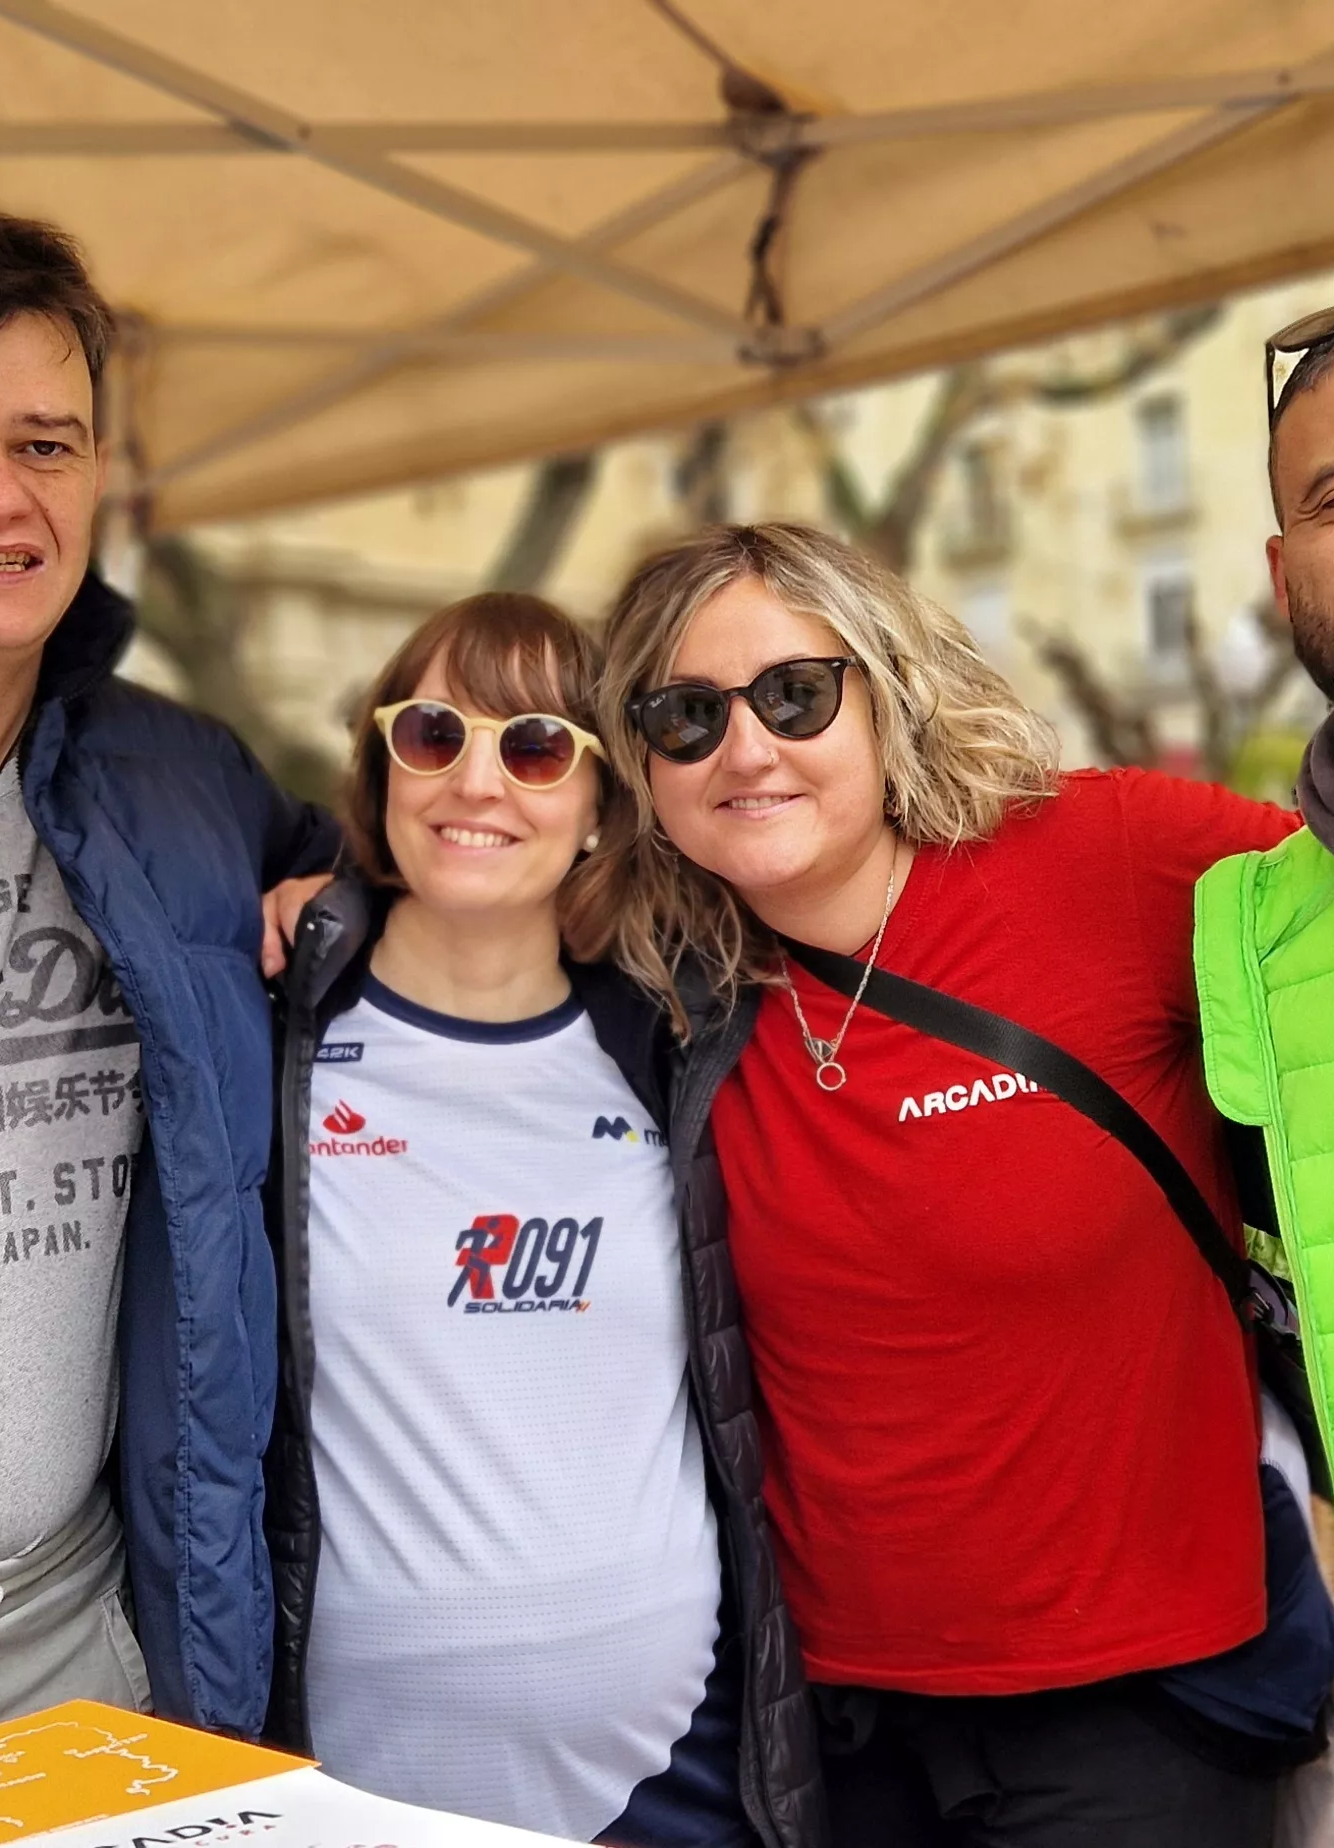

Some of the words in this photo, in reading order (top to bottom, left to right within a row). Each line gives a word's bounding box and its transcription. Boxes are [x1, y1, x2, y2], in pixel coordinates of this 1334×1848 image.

[308, 1136, 408, 1157] antander
[53, 1154, 130, 1206] STO
[464, 1299, 583, 1313] SOLIDARIA
